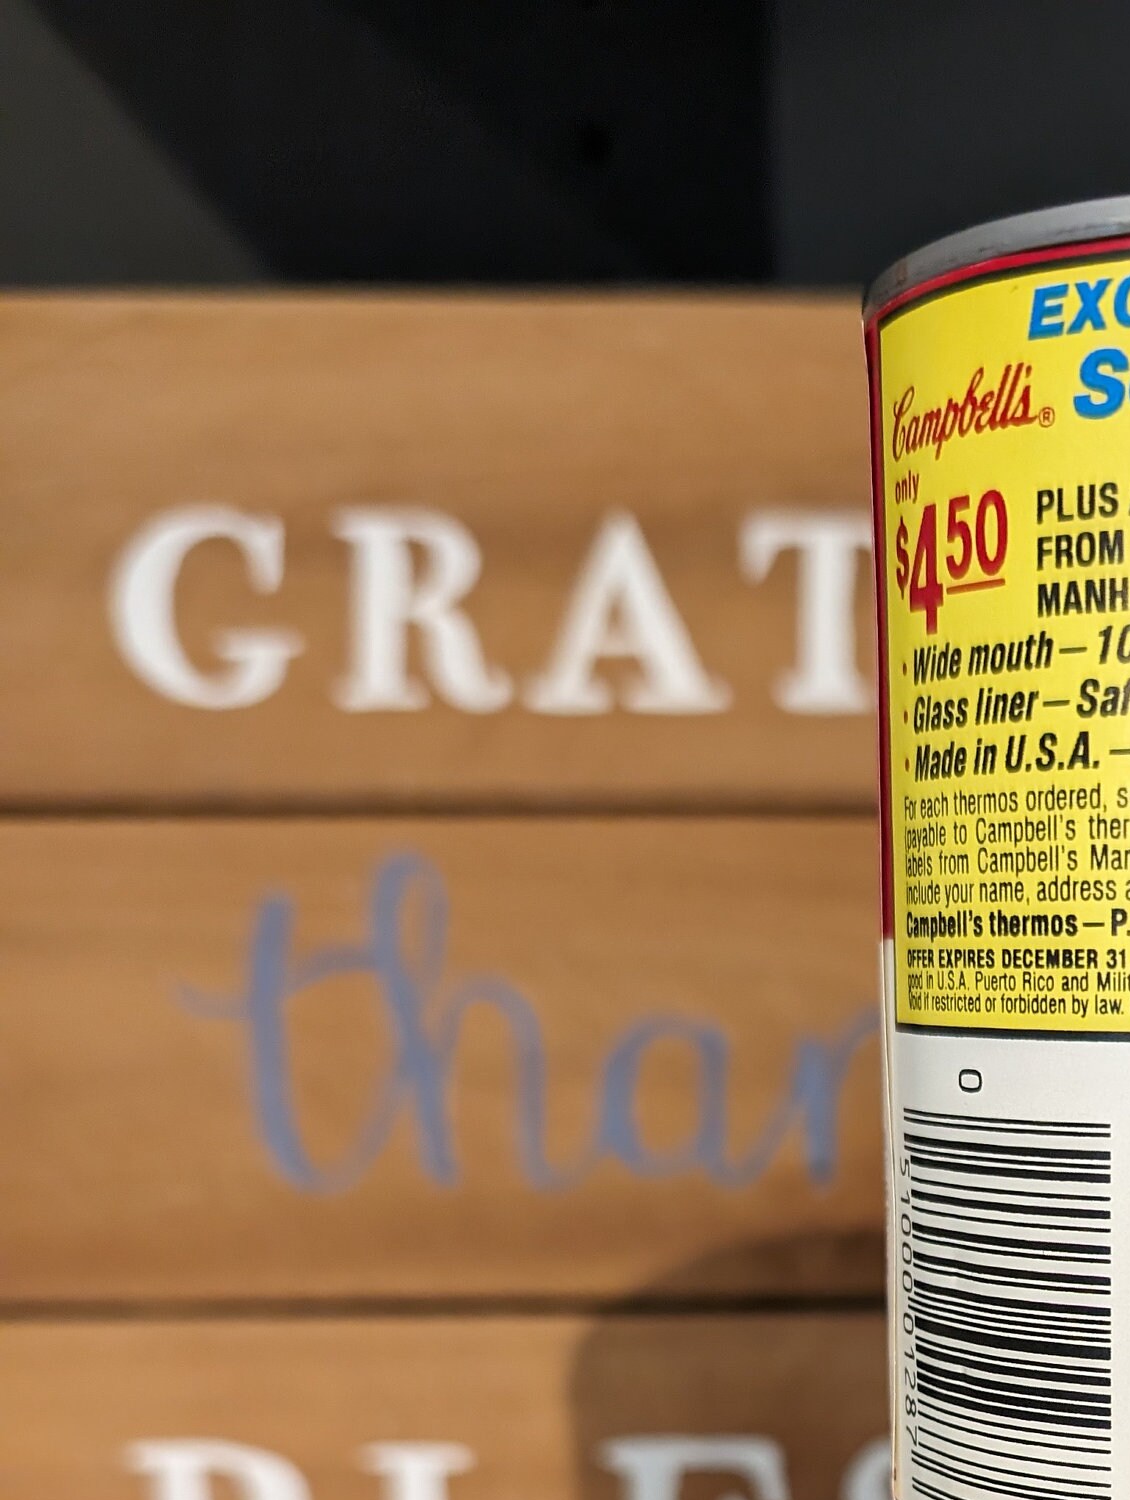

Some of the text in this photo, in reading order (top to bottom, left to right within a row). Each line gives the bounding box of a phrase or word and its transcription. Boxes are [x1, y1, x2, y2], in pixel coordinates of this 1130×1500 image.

[895, 470, 919, 504] only
[1037, 482, 1119, 525] PLUS
[1037, 530, 1124, 571] FROM
[108, 502, 878, 715] GRAT
[913, 643, 961, 686] Wide
[913, 696, 969, 734] Glass
[915, 741, 967, 782] Made
[974, 738, 997, 775] in
[1005, 731, 1099, 774] U.S.A.
[904, 796, 916, 821] For
[920, 793, 948, 818] each
[954, 788, 1018, 816] thermos
[1026, 783, 1107, 812] ordered,
[905, 821, 946, 852] (payable
[953, 822, 967, 844] to
[976, 815, 1076, 847] Campbell's
[906, 880, 940, 905] include
[945, 882, 973, 908] your
[980, 880, 1030, 906] name,
[1037, 875, 1116, 901] address
[906, 910, 983, 942] Campbell's
[908, 949, 934, 969] OFFER
[939, 949, 995, 969] EXPIRES
[1001, 949, 1098, 969] DECEMBER
